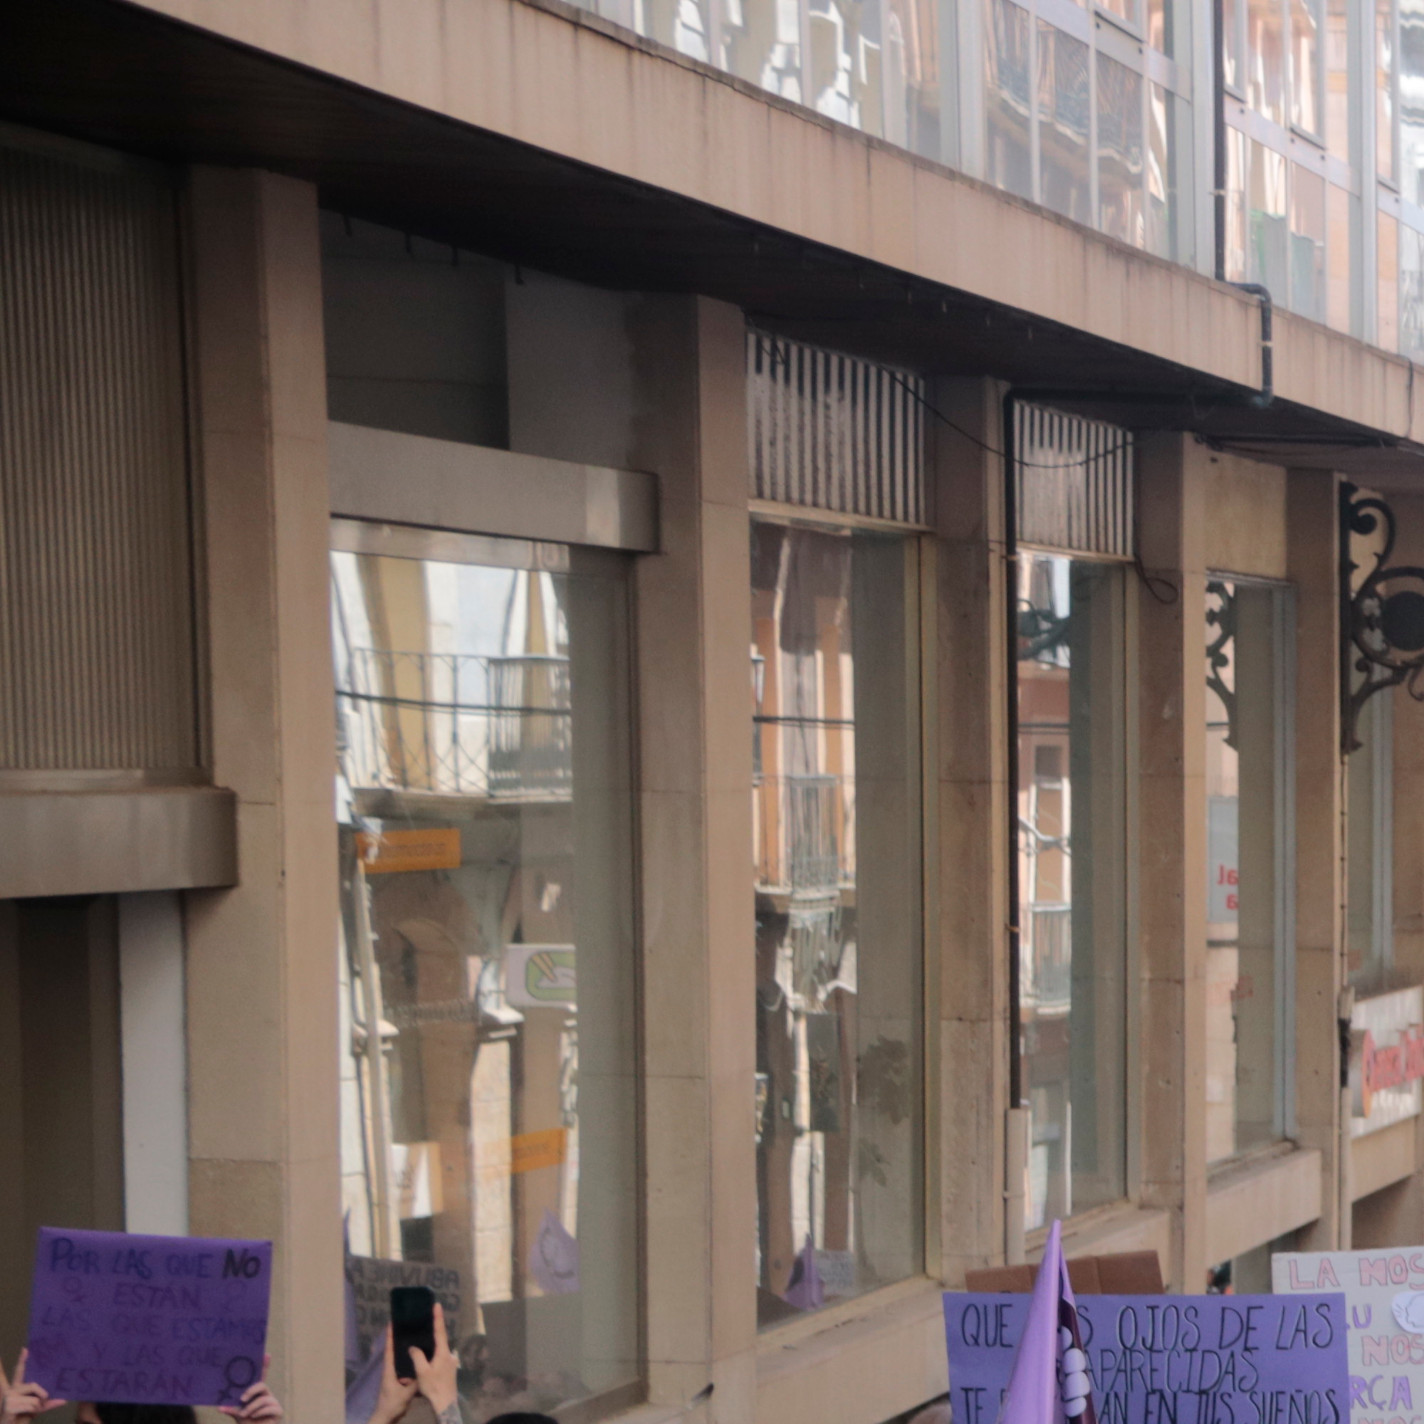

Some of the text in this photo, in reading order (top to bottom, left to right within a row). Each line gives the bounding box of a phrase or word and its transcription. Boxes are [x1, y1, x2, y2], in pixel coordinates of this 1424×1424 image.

[1288, 1257, 1341, 1290] LA
[961, 1303, 1014, 1348] QUE
[1116, 1304, 1203, 1352] OJOS
[1218, 1305, 1266, 1352] DE
[1274, 1302, 1334, 1350] LAS
[1350, 1374, 1413, 1411] RÇA
